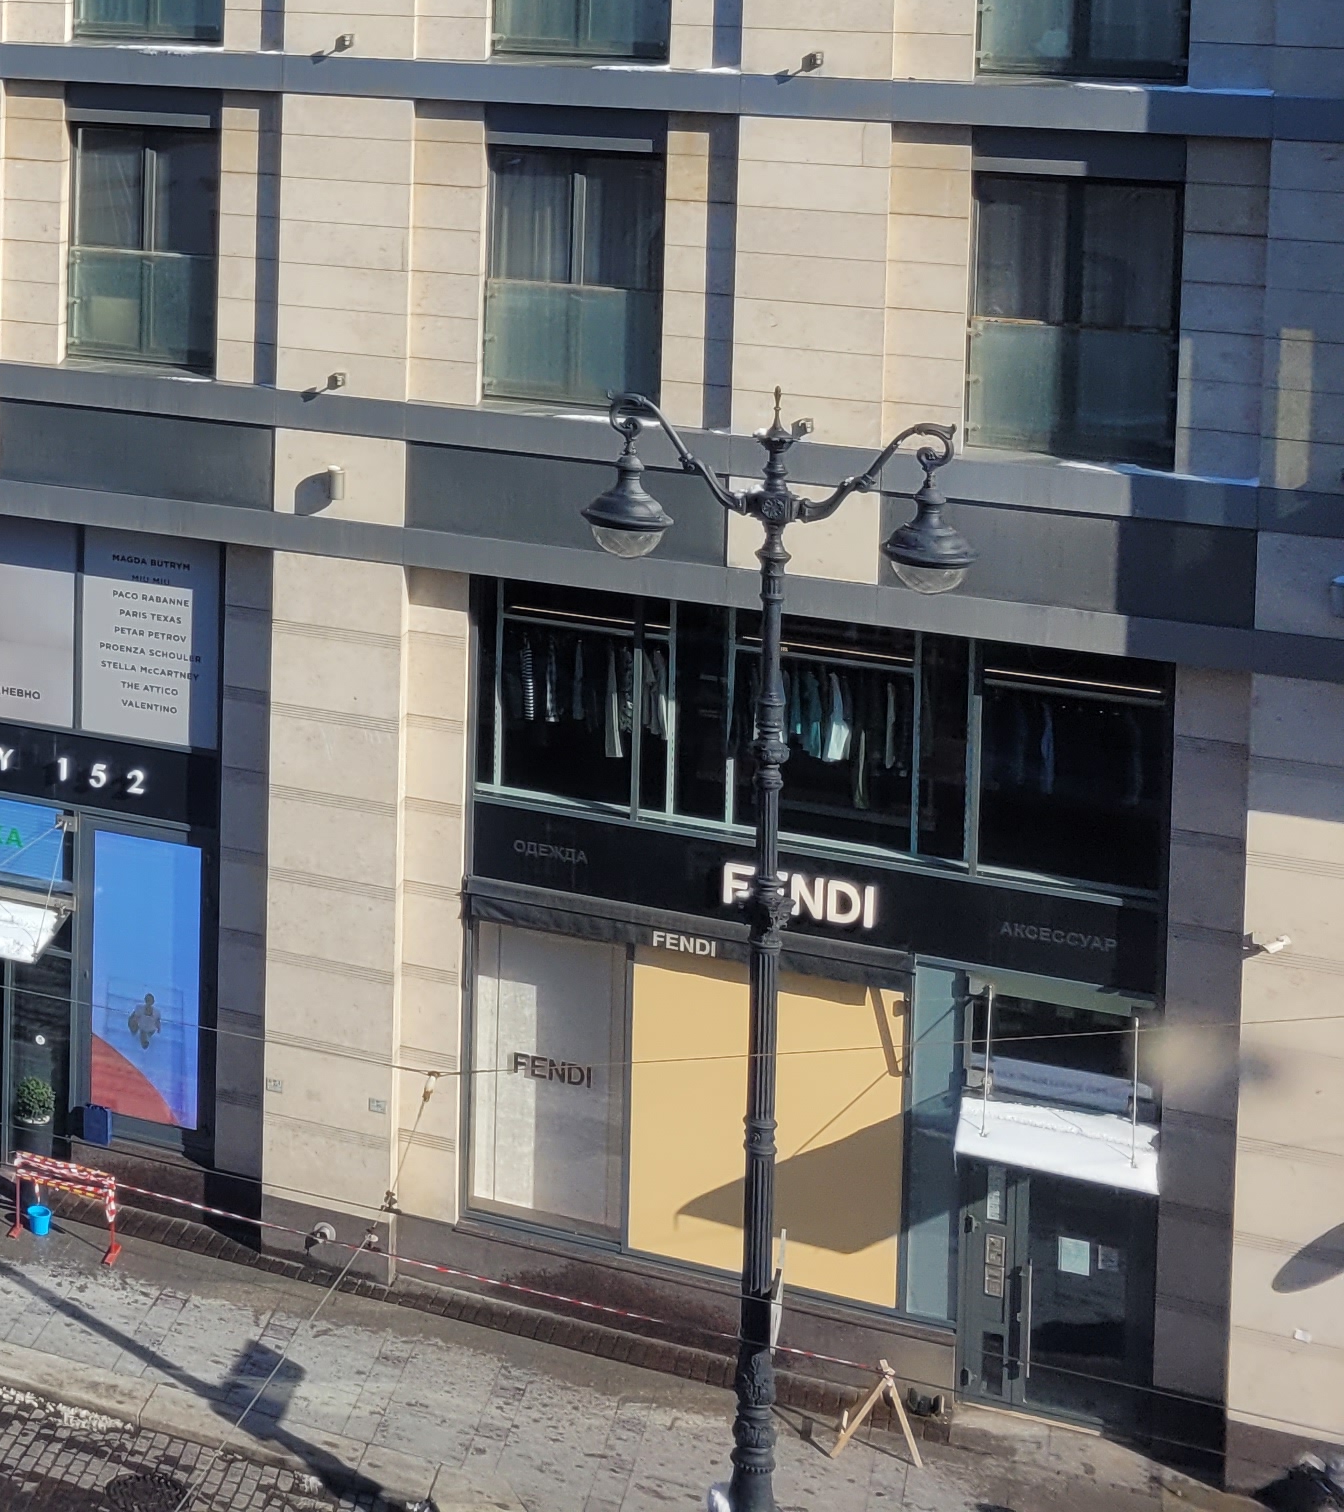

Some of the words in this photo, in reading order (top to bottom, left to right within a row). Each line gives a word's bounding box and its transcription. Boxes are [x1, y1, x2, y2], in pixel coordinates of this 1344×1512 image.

[112, 554, 147, 565] MAGDA
[150, 559, 191, 571] BUTRYM
[112, 589, 138, 600] PACO
[141, 594, 189, 607] RABANNE
[119, 608, 147, 619] PARIS
[150, 613, 182, 624] TEXAS
[114, 626, 145, 637] PETAR
[148, 631, 187, 643] PETROV
[99, 641, 145, 656] PROENZA
[148, 649, 202, 663] SCHOULER
[100, 660, 136, 672] STELLA
[140, 666, 199, 681] McCARTNEY
[120, 680, 140, 690] THE
[142, 684, 178, 696] ATTICO
[121, 699, 178, 714] VALENTINO
[513, 839, 588, 864] ОДЕЖДА
[722, 862, 875, 929] FNDI
[652, 930, 716, 958] FENDI
[513, 1051, 592, 1088] FENDI
